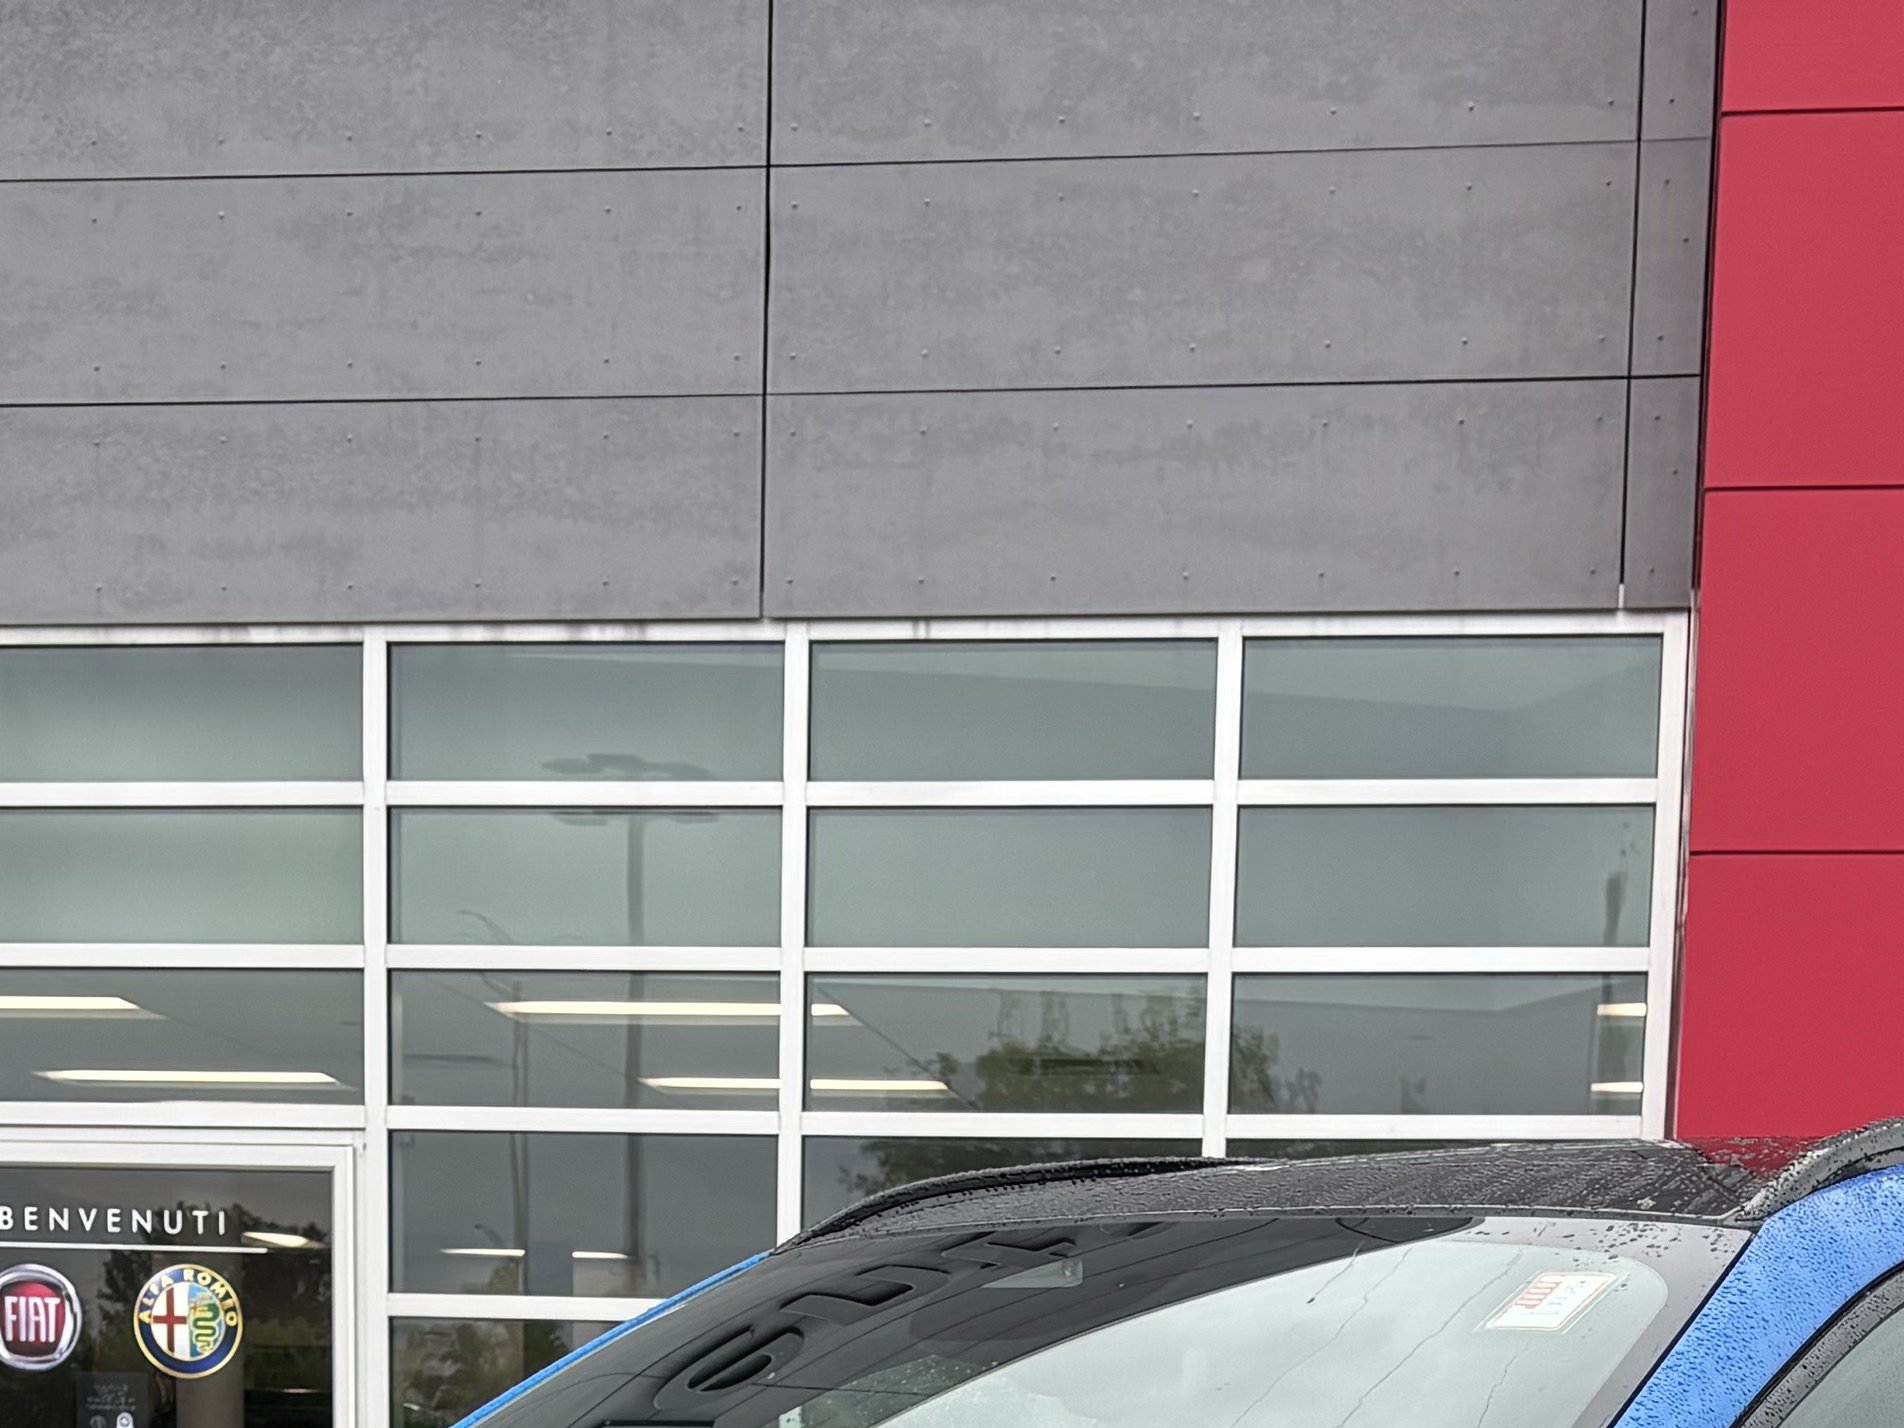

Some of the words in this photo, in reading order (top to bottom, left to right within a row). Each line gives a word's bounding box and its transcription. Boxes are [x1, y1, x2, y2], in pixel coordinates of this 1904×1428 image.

[4, 1296, 60, 1342] FIAT
[138, 1276, 175, 1324] ALFA
[183, 1268, 237, 1326] ROMEO
